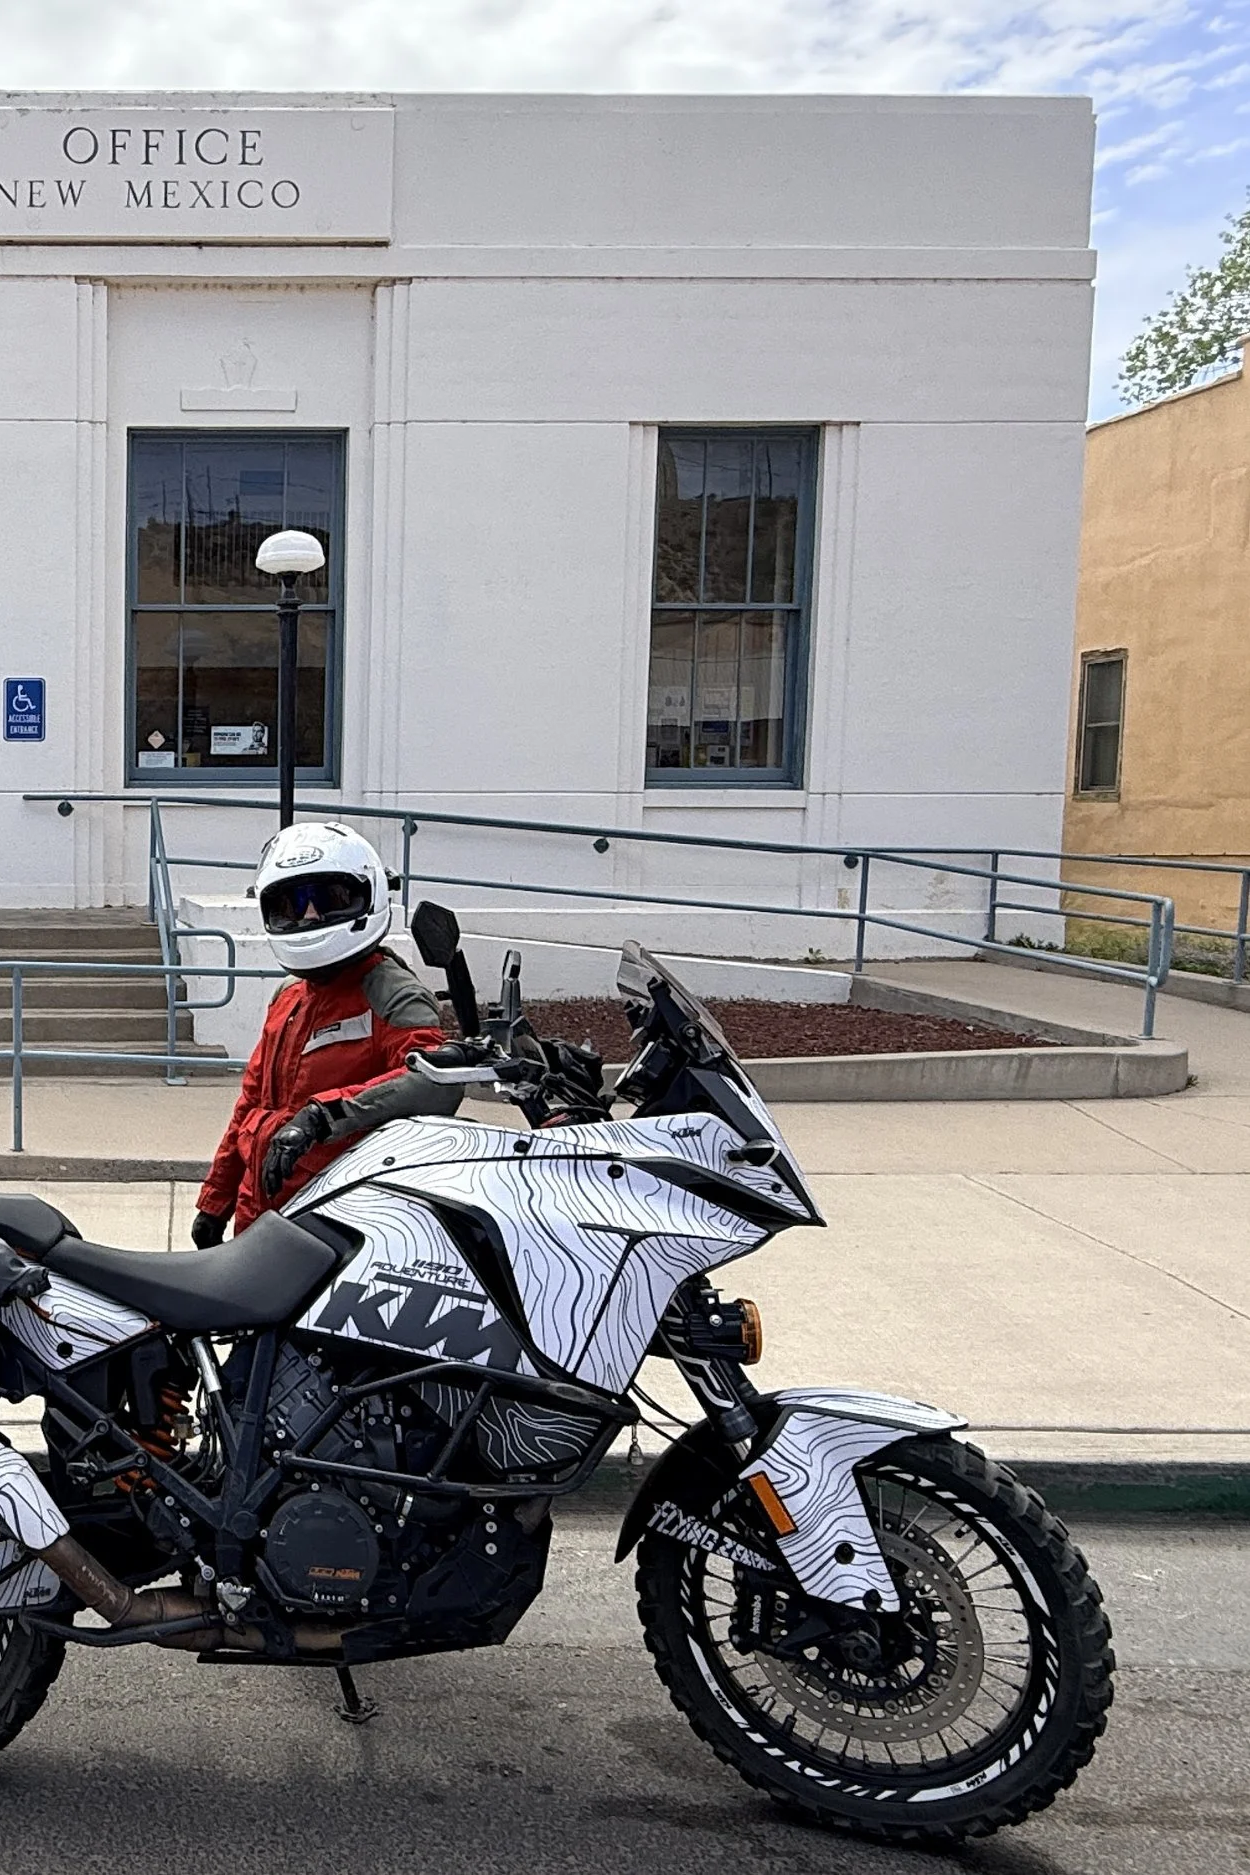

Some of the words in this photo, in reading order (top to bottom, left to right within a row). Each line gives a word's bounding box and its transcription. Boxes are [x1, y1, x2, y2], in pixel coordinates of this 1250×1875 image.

[63, 127, 264, 167] OFFICE
[125, 180, 301, 209] MEXICO
[8, 714, 40, 723] ACCESSIBLE
[10, 725, 38, 734] ENTRANCE
[370, 1261, 471, 1289] ADVENTURE
[412, 1259, 463, 1275] 1190
[313, 1272, 524, 1373] KTM
[646, 1500, 720, 1552] FLYING
[750, 1594, 762, 1634] brembo
